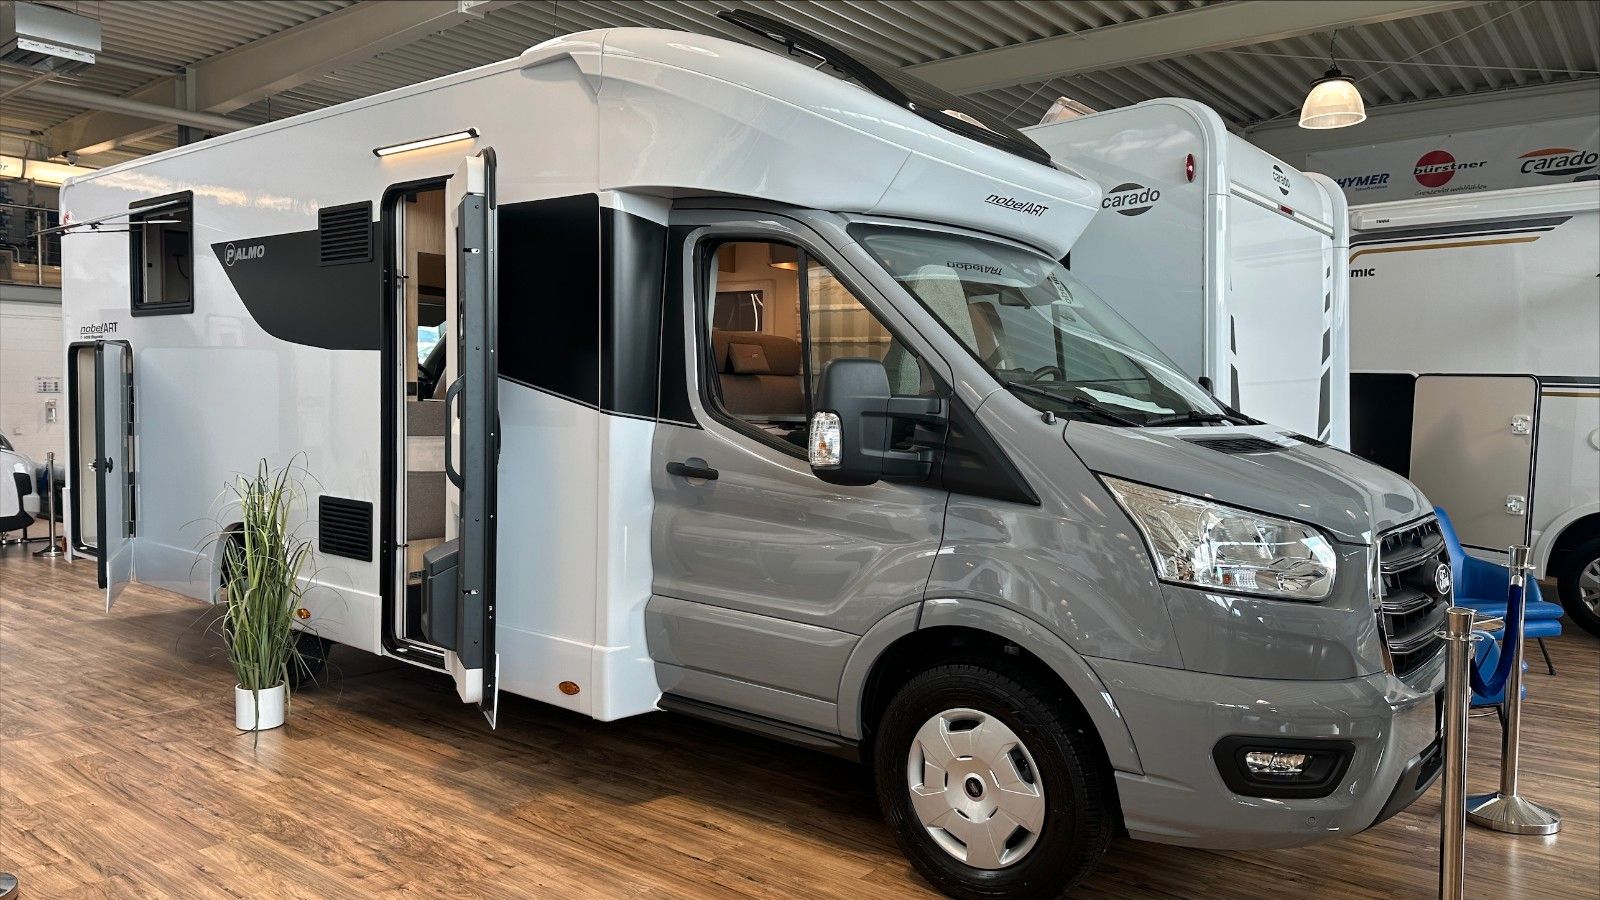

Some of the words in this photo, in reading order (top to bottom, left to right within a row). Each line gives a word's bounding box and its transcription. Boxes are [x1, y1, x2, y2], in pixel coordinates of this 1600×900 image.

[1412, 160, 1487, 176] bürstner
[1520, 150, 1599, 174] carado
[1272, 170, 1291, 189] carado
[1337, 173, 1390, 188] HYMER
[984, 194, 1049, 217] nobelART
[1101, 187, 1160, 209] carado
[225, 243, 265, 267] PALMO
[1349, 268, 1376, 278] mic
[80, 321, 118, 334] nobelART
